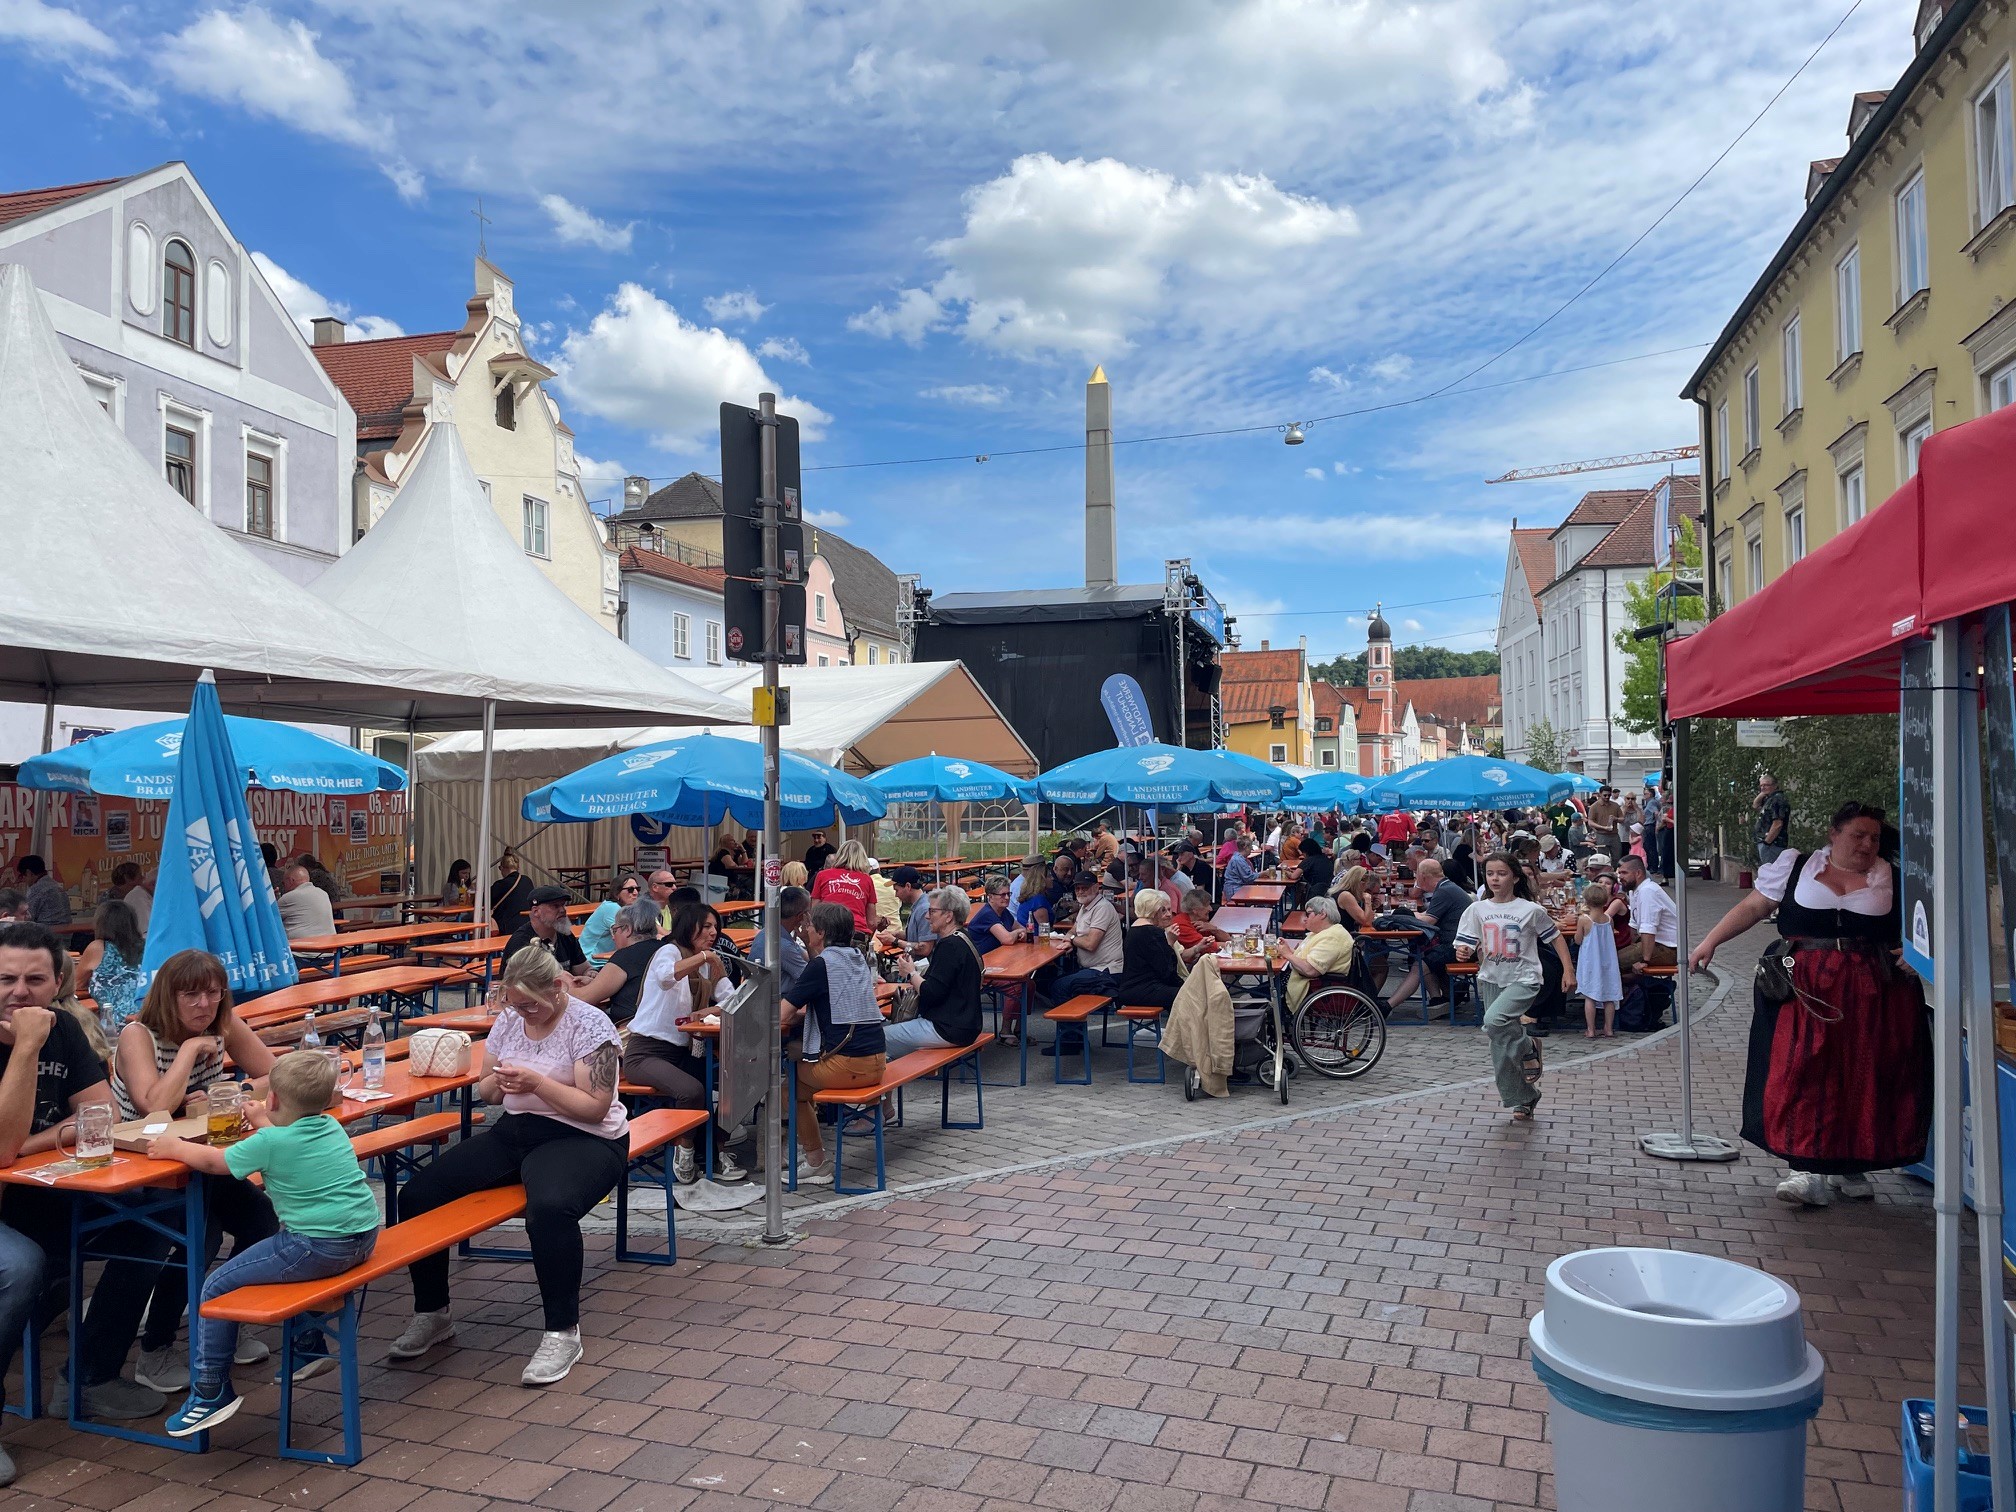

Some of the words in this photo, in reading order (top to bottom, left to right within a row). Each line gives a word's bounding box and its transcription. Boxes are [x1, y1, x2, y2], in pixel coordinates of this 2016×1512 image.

[126, 774, 175, 784] LANDS
[272, 775, 291, 784] DAS
[293, 778, 315, 787] BIER
[317, 776, 335, 788] FÜR
[337, 778, 363, 788] HIER
[706, 780, 732, 790] DAS
[784, 794, 812, 804] HIER
[952, 784, 992, 792] LANDSHUTER
[1127, 784, 1189, 793] LANDSHUTER
[1244, 788, 1257, 798] FÜR
[1257, 788, 1273, 796] HIER
[580, 789, 658, 803] LANDSHUTER
[1046, 790, 1060, 798] DAS
[1076, 790, 1088, 799] FÜR
[1134, 792, 1182, 800] BRAUHAUS
[1492, 792, 1535, 802] LANDSHUTER
[588, 800, 648, 814] BRAUHAUS
[1438, 798, 1450, 807] FÜR
[1452, 800, 1466, 808] HIER
[1498, 800, 1532, 808] BRAUHAUS
[371, 815, 404, 836] JUNI
[73, 828, 100, 836] NICKI
[1481, 914, 1502, 922] LAGUNA
[1504, 914, 1523, 923] BEACH
[1482, 923, 1522, 958] 06
